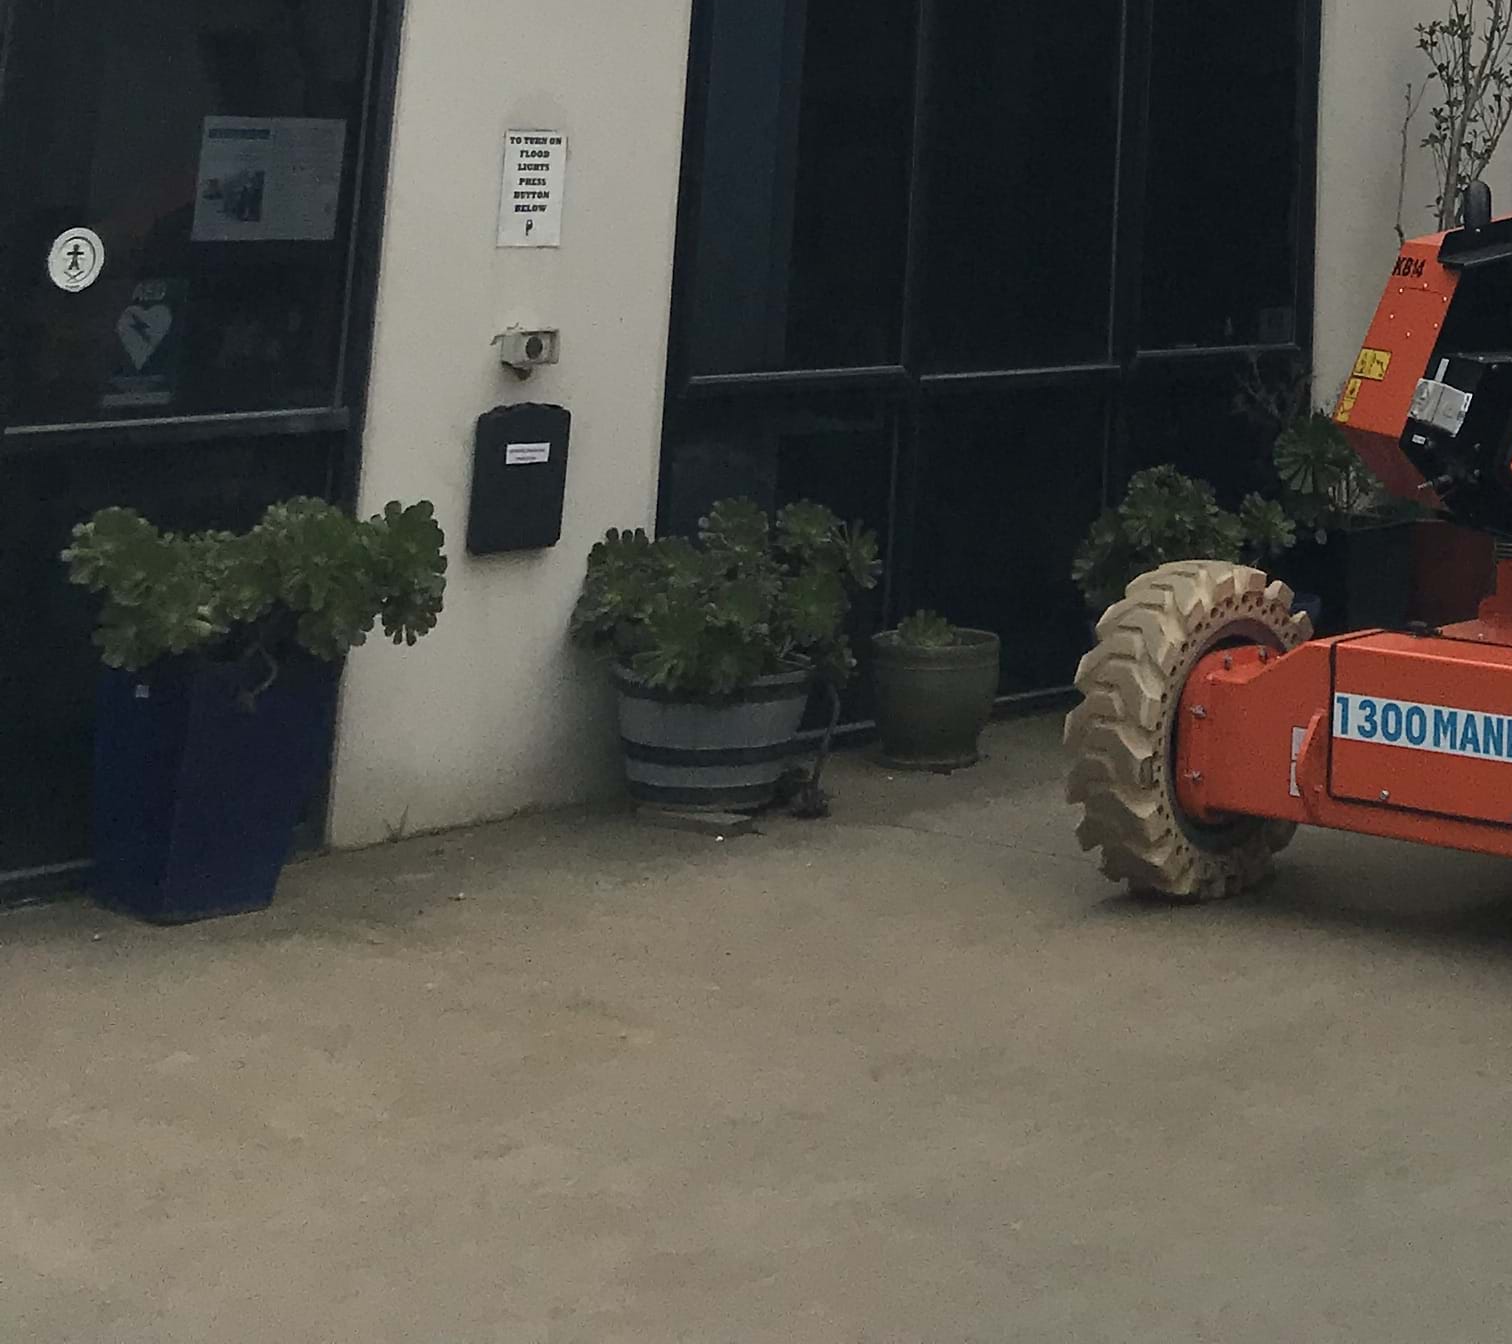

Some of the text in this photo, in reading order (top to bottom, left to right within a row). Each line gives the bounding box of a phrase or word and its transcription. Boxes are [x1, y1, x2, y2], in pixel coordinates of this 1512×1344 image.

[509, 136, 562, 145] TO TURN ON
[520, 150, 550, 158] FLOOD
[517, 163, 550, 171] LIGHTS
[518, 178, 546, 186] PRESS
[513, 191, 550, 199] BUTTON
[514, 204, 547, 213] BELOW
